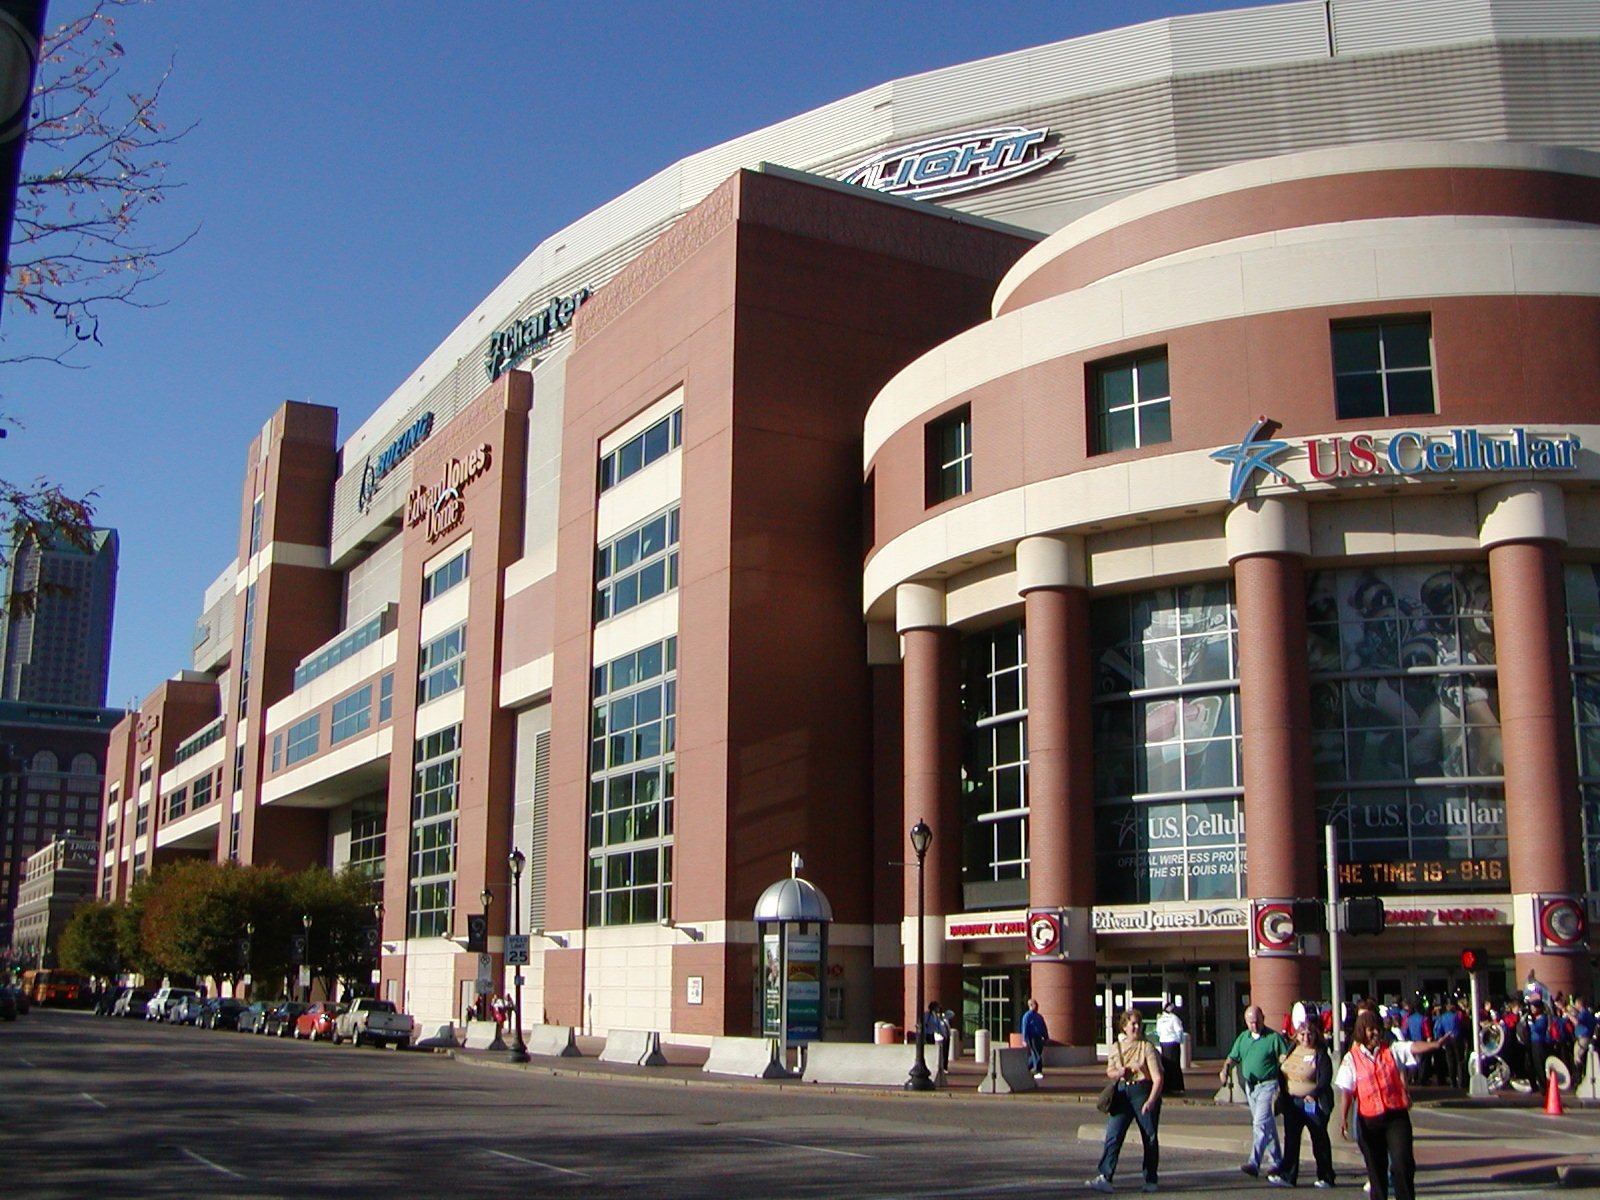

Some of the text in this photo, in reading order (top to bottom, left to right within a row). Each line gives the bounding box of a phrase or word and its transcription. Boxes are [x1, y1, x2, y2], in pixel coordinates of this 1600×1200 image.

[866, 127, 1049, 190] LIGHT
[503, 286, 588, 359] Charter
[375, 411, 434, 478] BOEING
[1303, 427, 1581, 479] U.S. Cellular
[407, 443, 487, 523] Edward Jones
[426, 499, 462, 541] Dome
[1186, 812, 1246, 837] Cellul
[1408, 801, 1503, 826] Cellular
[1148, 867, 1168, 878] THE
[1324, 864, 1363, 884] HE
[1369, 862, 1417, 883] TIME
[1423, 861, 1443, 882] IS
[1091, 908, 1242, 929] Edward Jones Dome
[508, 951, 528, 963] 25
